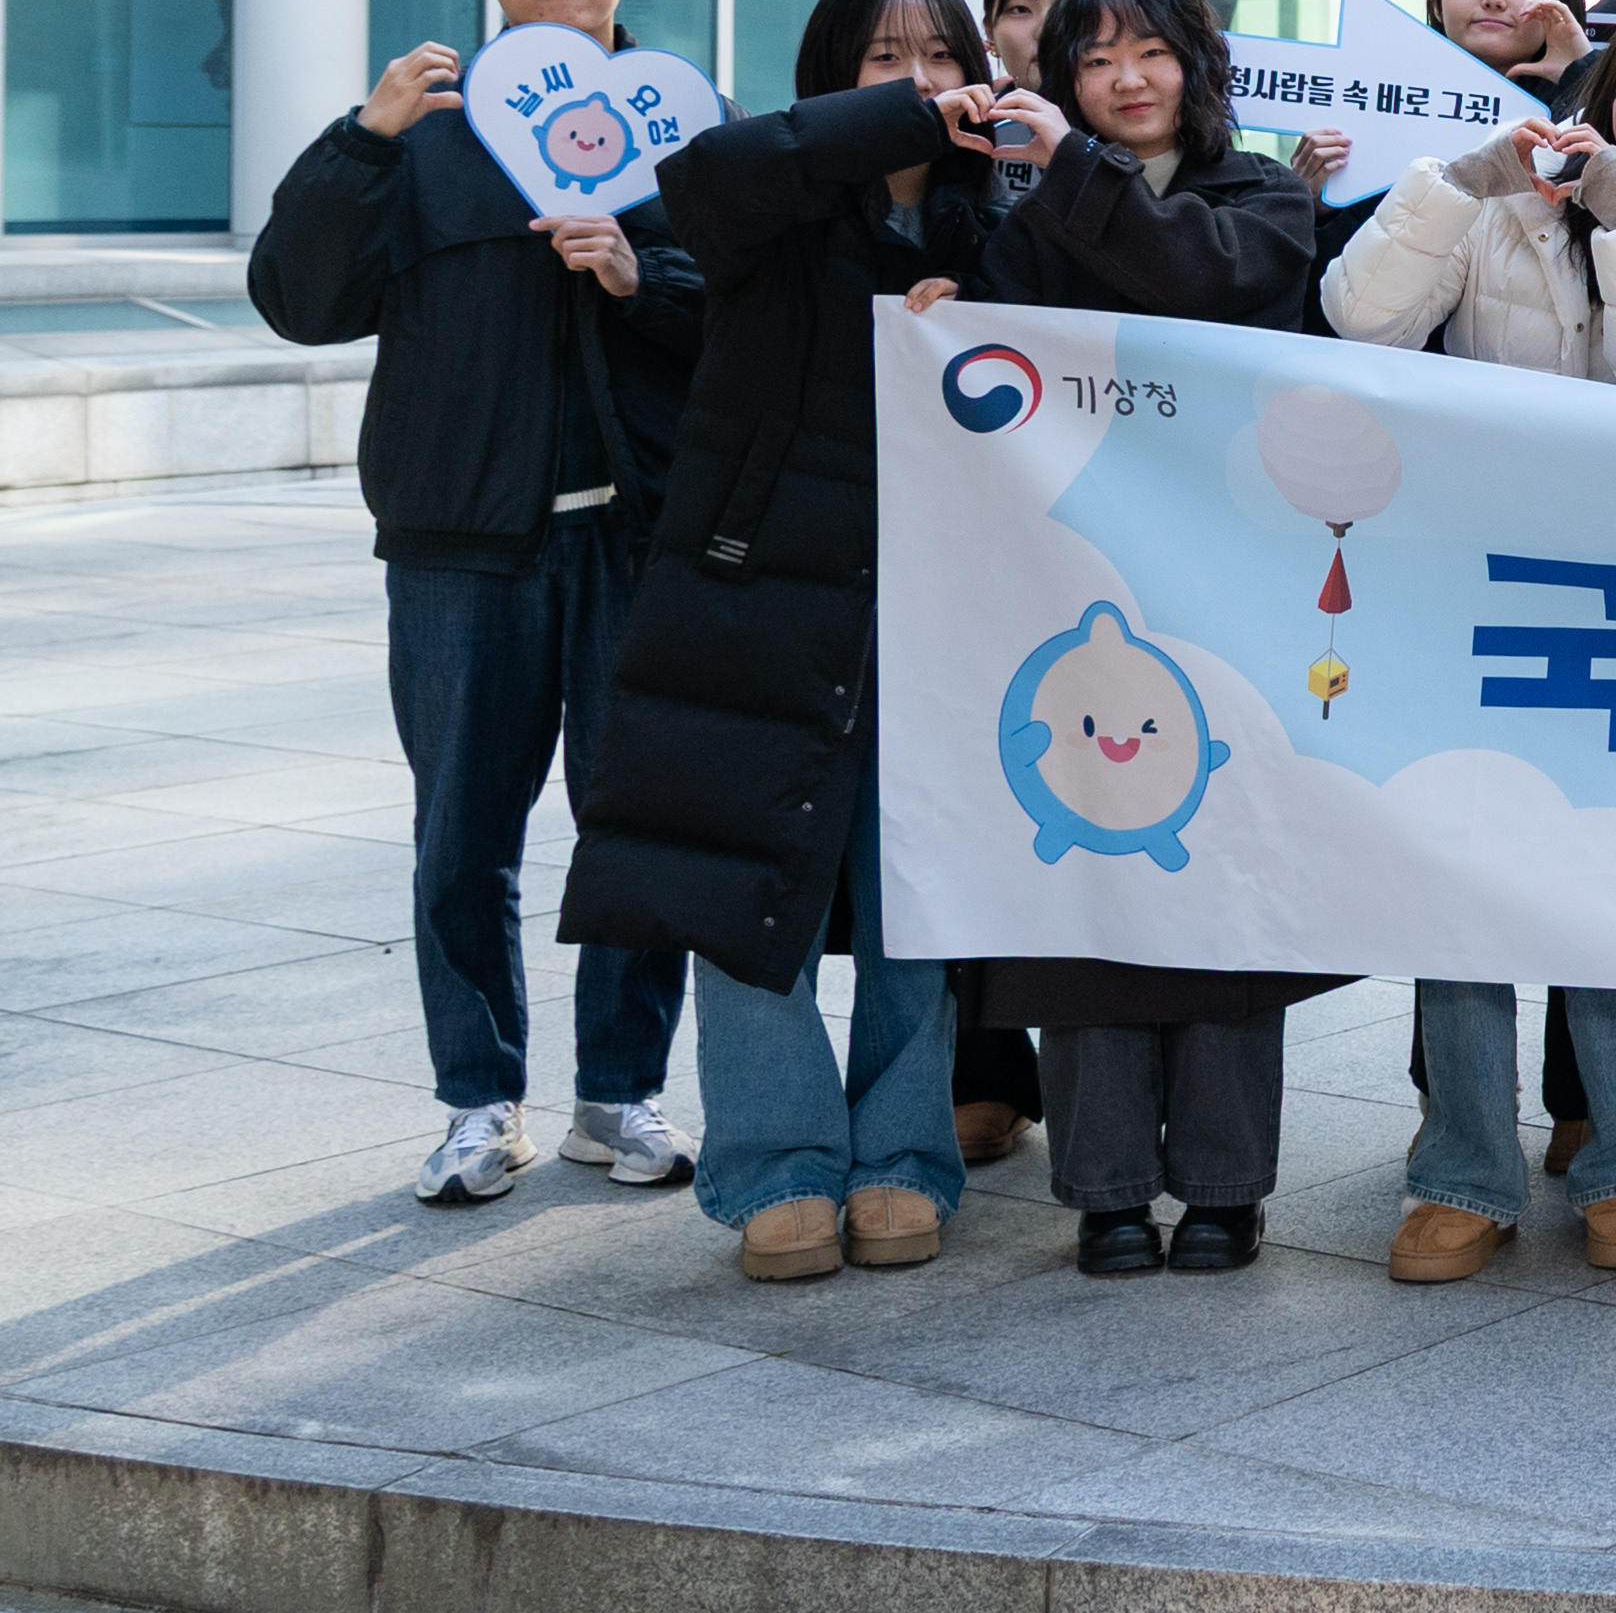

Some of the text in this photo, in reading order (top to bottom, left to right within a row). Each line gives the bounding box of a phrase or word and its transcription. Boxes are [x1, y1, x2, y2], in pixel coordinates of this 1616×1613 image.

[505, 62, 681, 145] 날씨 요정
[1343, 80, 1369, 111] 속
[1377, 83, 1430, 118] 바로
[1437, 91, 1501, 125] 그곳!
[1062, 376, 1177, 418] 기상청
